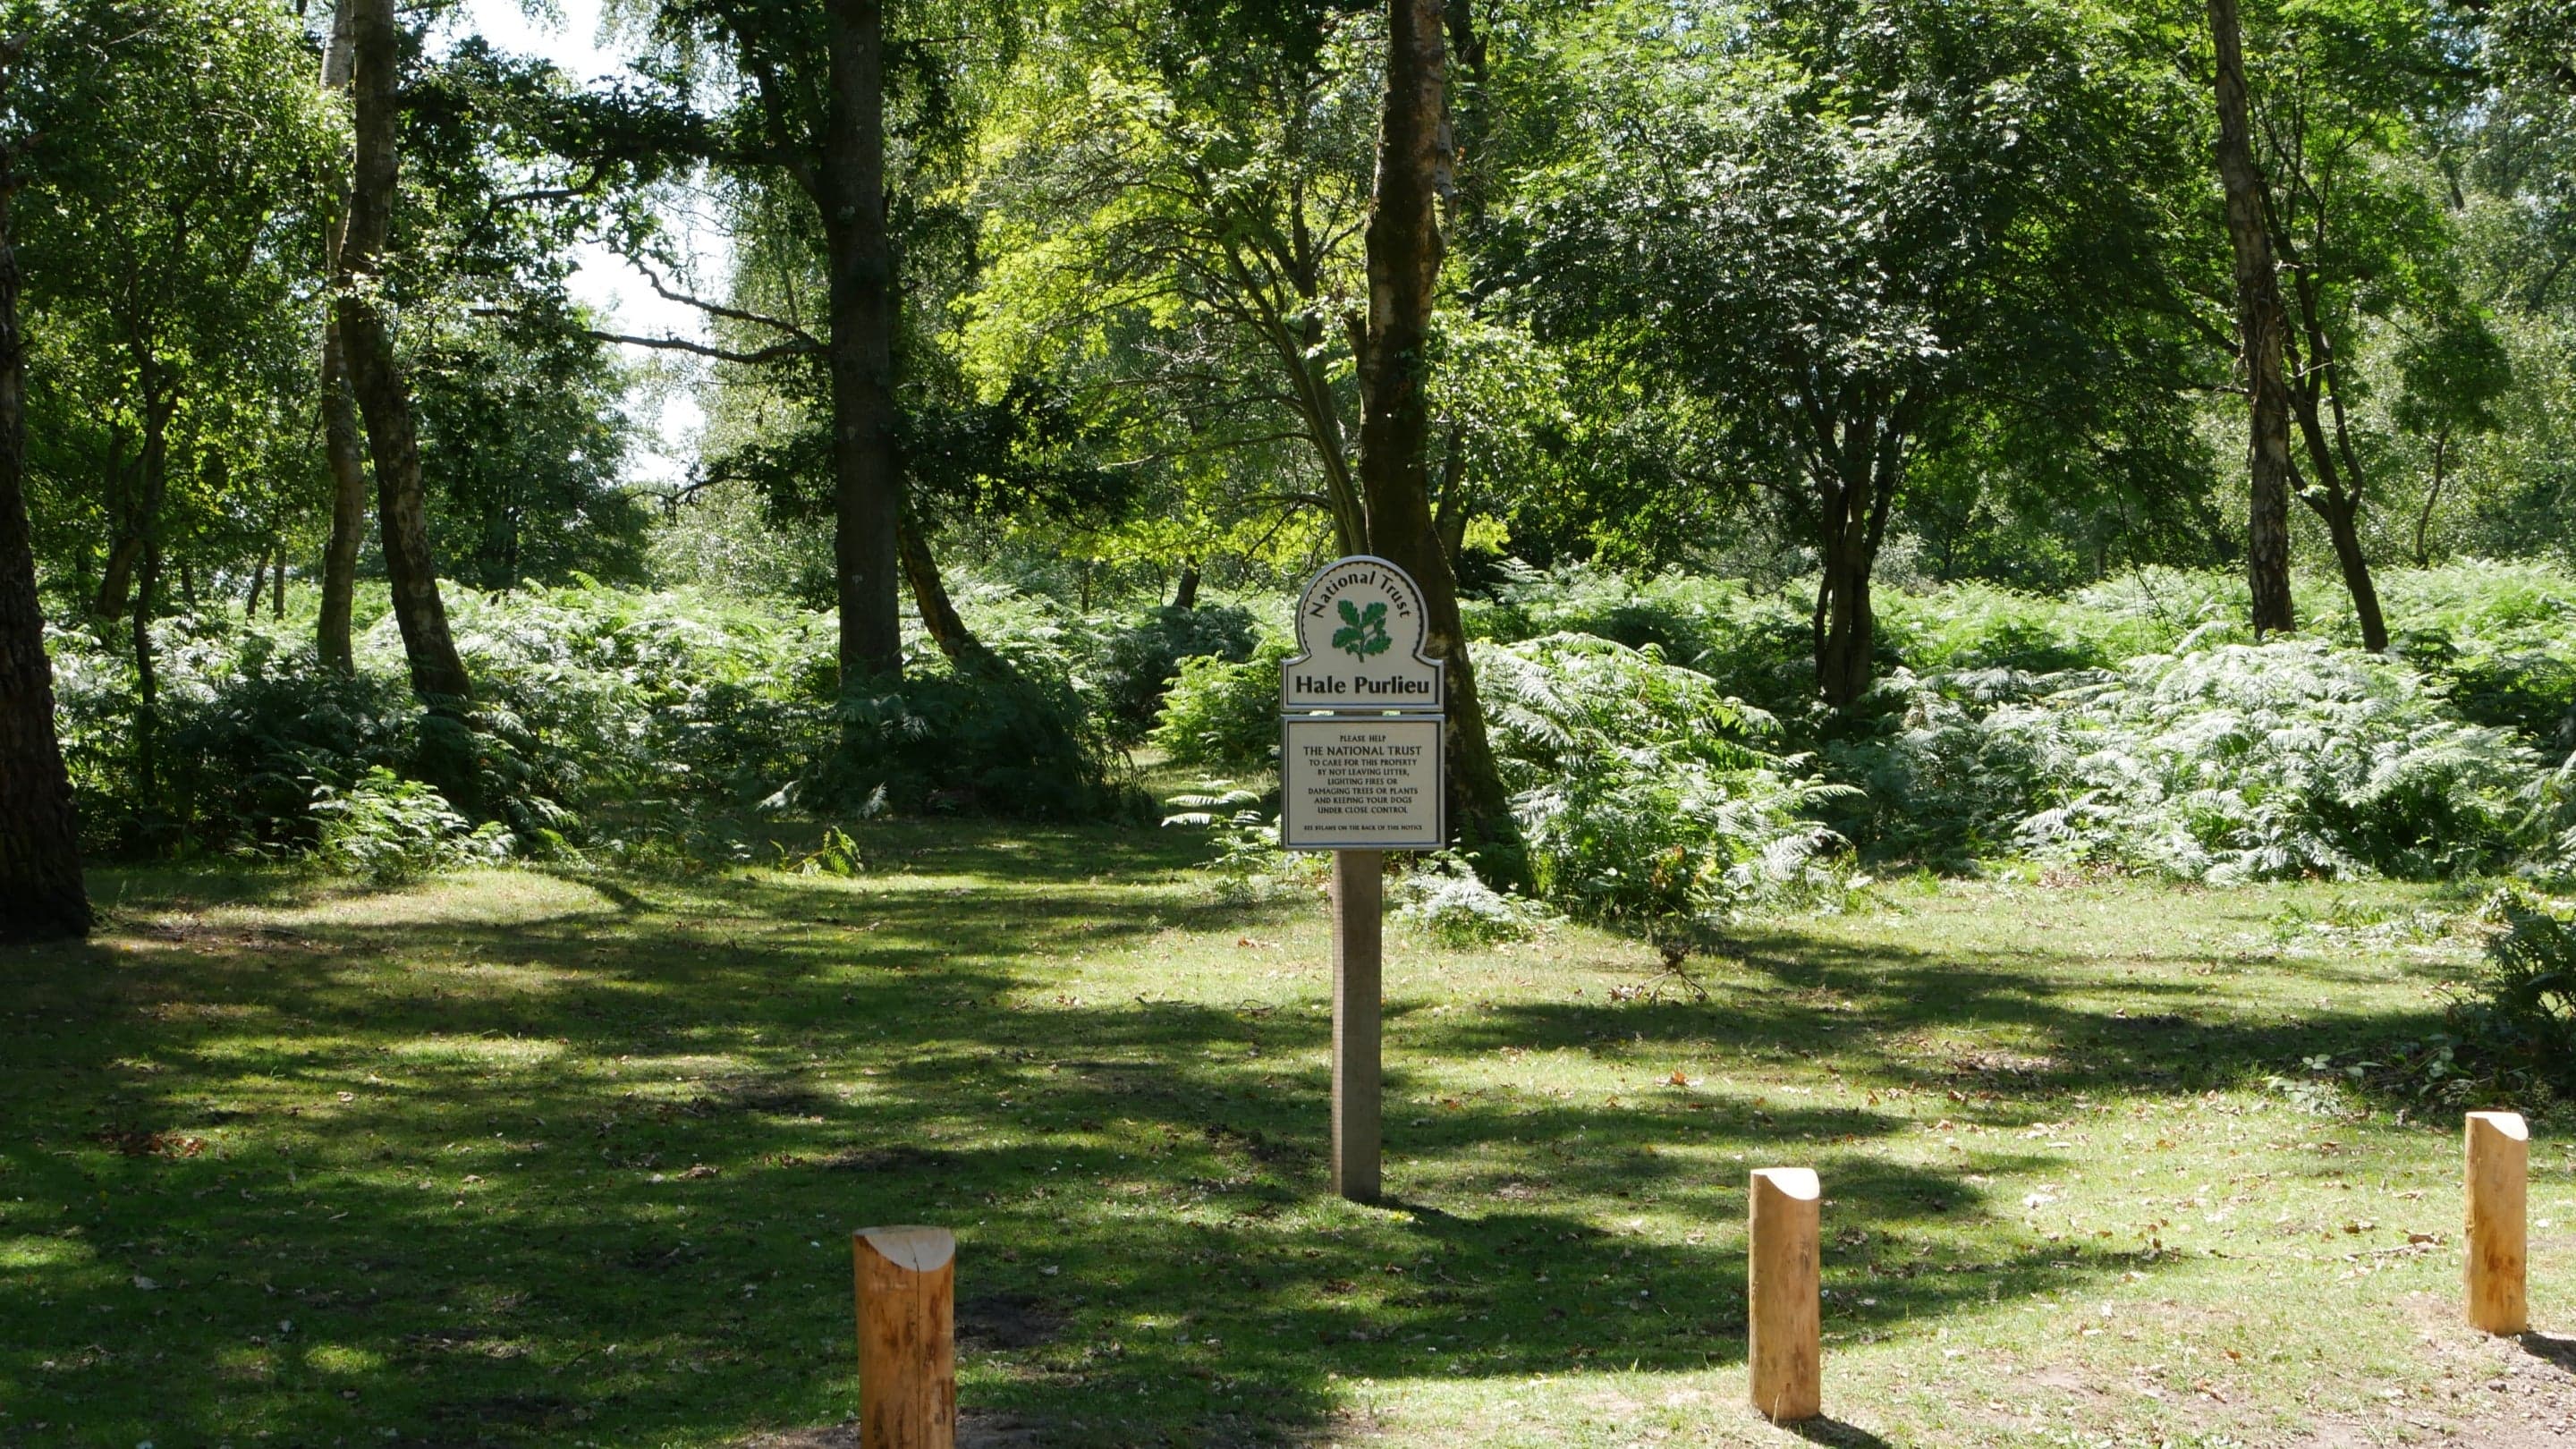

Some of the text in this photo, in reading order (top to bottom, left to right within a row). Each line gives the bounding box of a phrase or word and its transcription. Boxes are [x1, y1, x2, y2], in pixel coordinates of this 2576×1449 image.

[1310, 571, 1411, 618] National Trust
[1296, 675, 1429, 694] Hale Purlieu
[1303, 746, 1421, 756] THE NATIONAL TRUST
